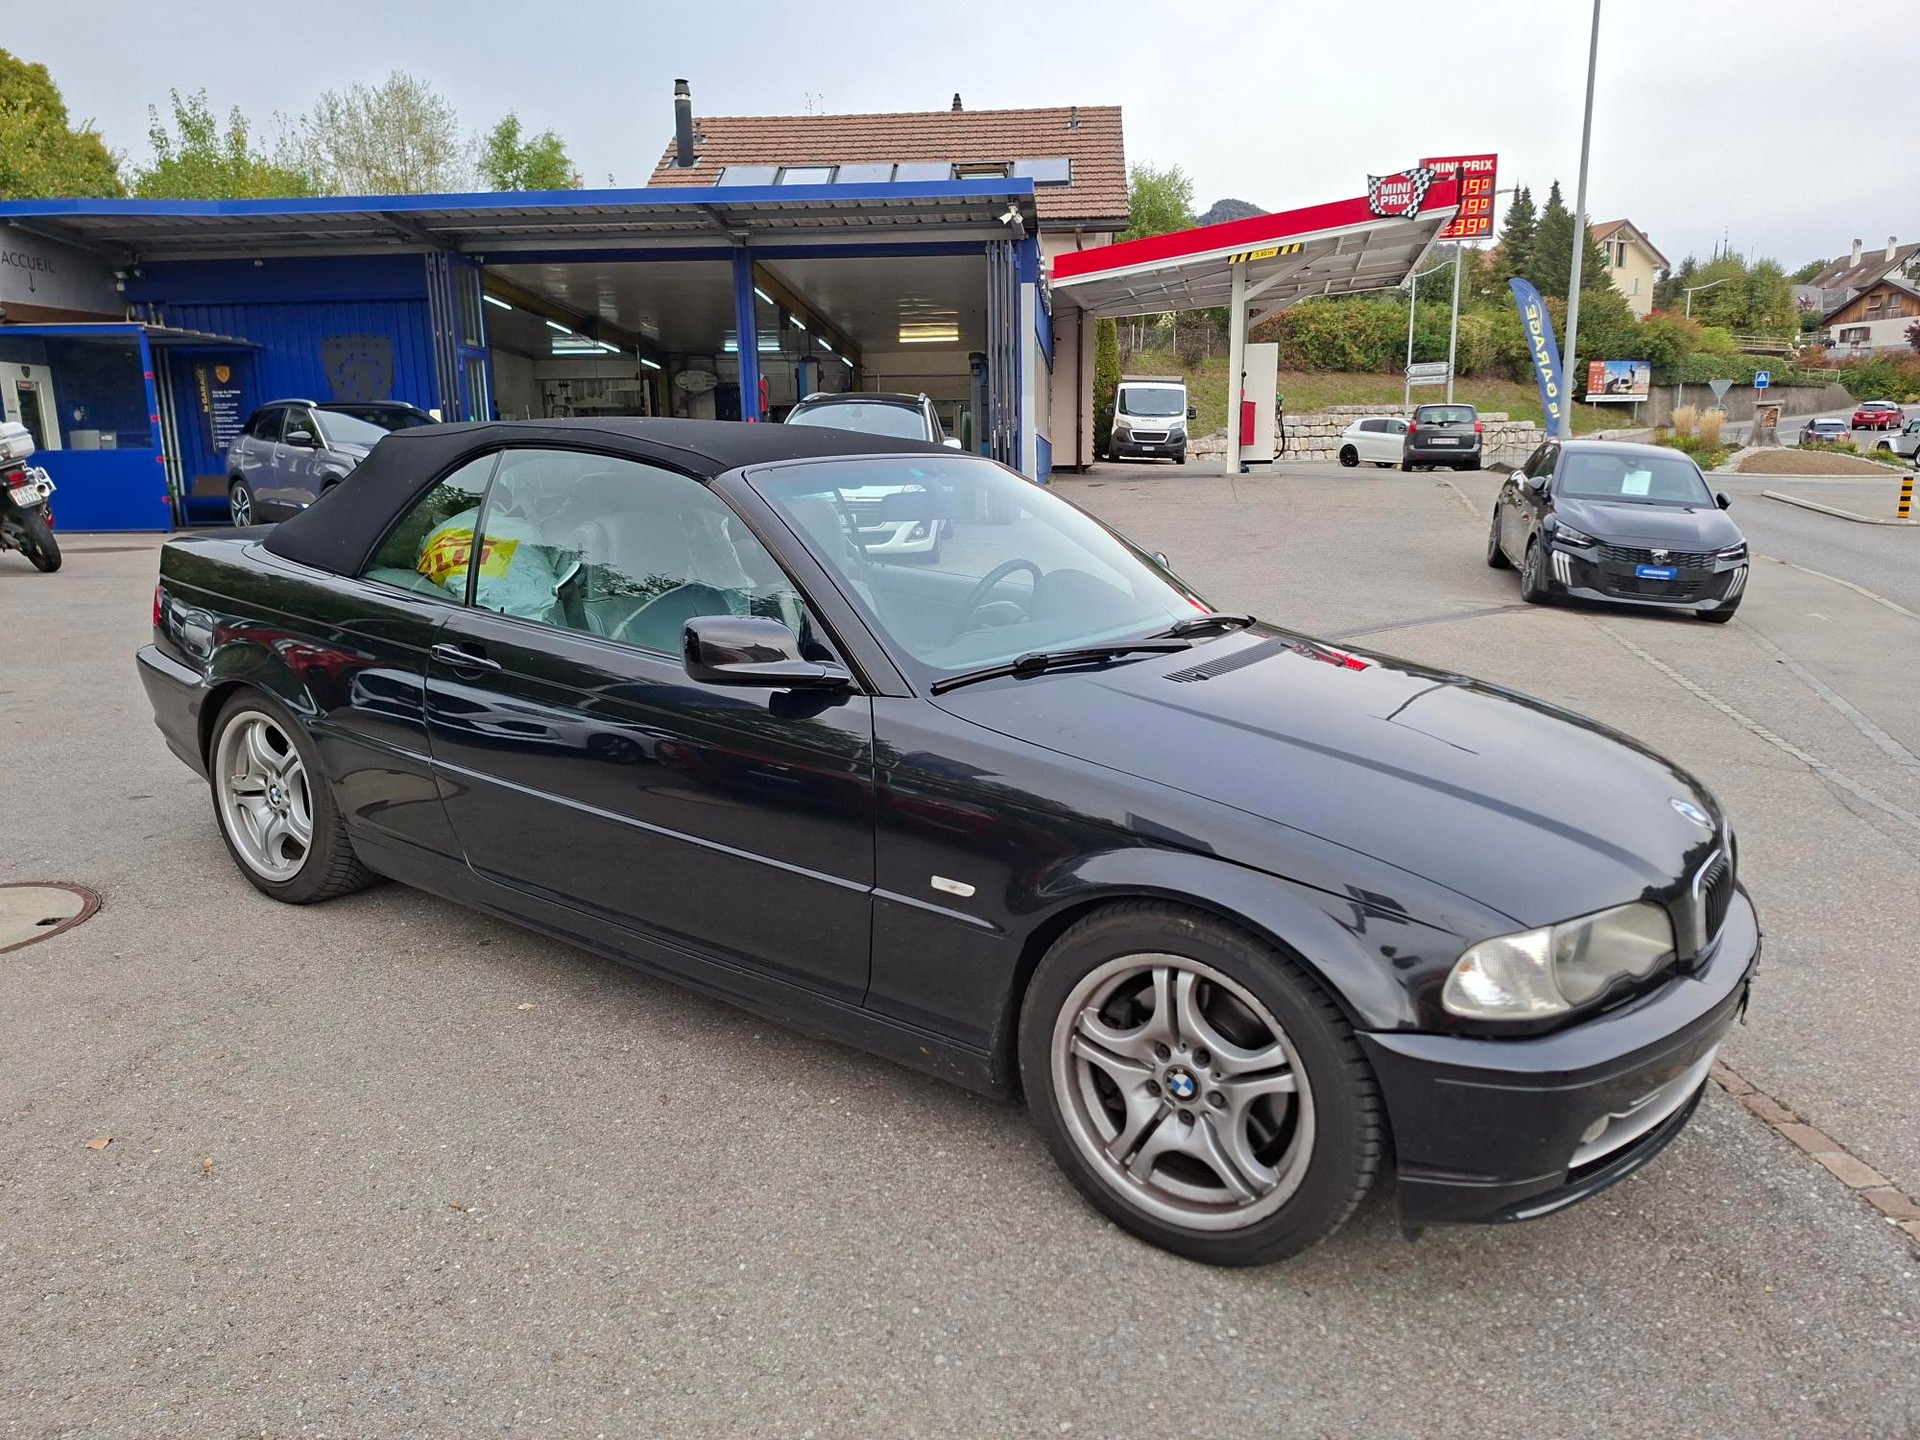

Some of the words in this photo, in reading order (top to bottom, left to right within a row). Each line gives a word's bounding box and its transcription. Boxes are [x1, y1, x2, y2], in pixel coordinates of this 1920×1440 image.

[1429, 162, 1458, 174] MINI
[1462, 159, 1493, 172] PRIX
[1380, 181, 1411, 195] MINI
[1380, 193, 1411, 206] PRIX
[1, 250, 55, 274] ACCUEIL
[198, 368, 208, 404] GARAGE
